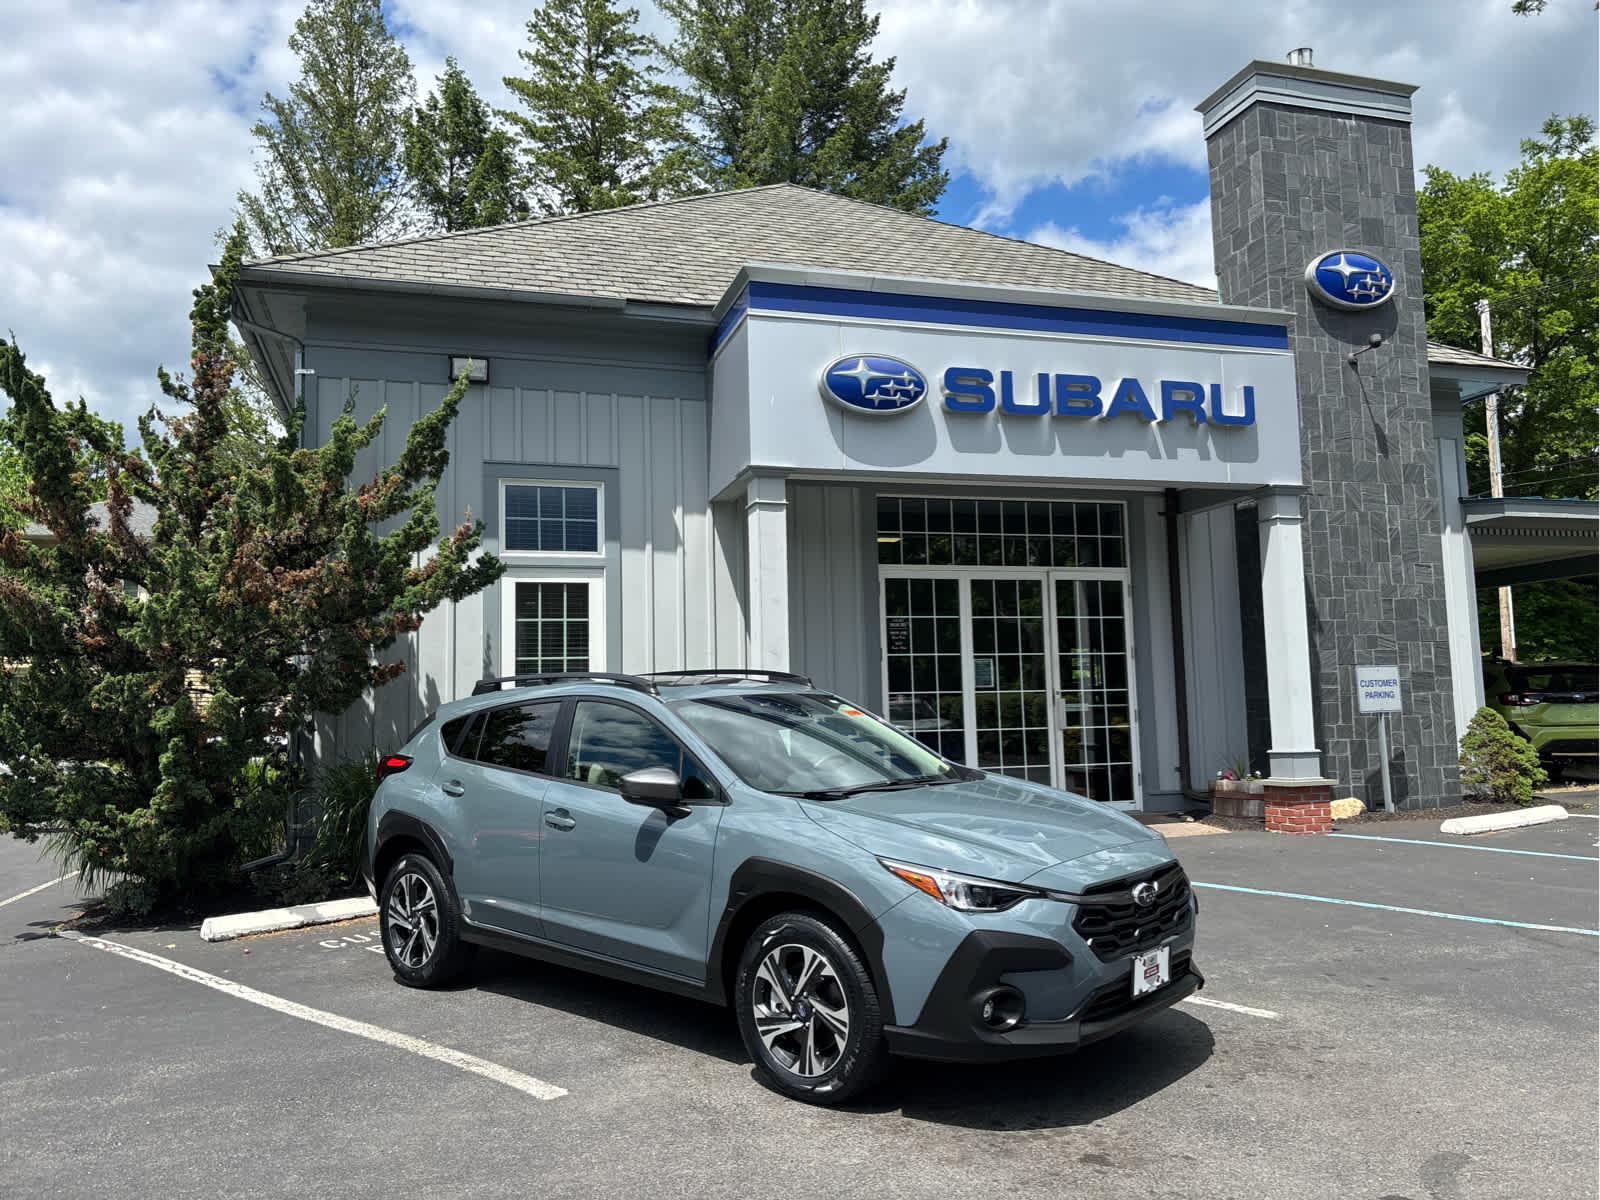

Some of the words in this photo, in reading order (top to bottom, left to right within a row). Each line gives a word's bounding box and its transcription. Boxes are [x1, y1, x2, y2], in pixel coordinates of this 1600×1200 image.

[942, 366, 1257, 426] SUBARU
[1359, 679, 1398, 688] CUSTOMER
[1365, 690, 1395, 699] PARKING
